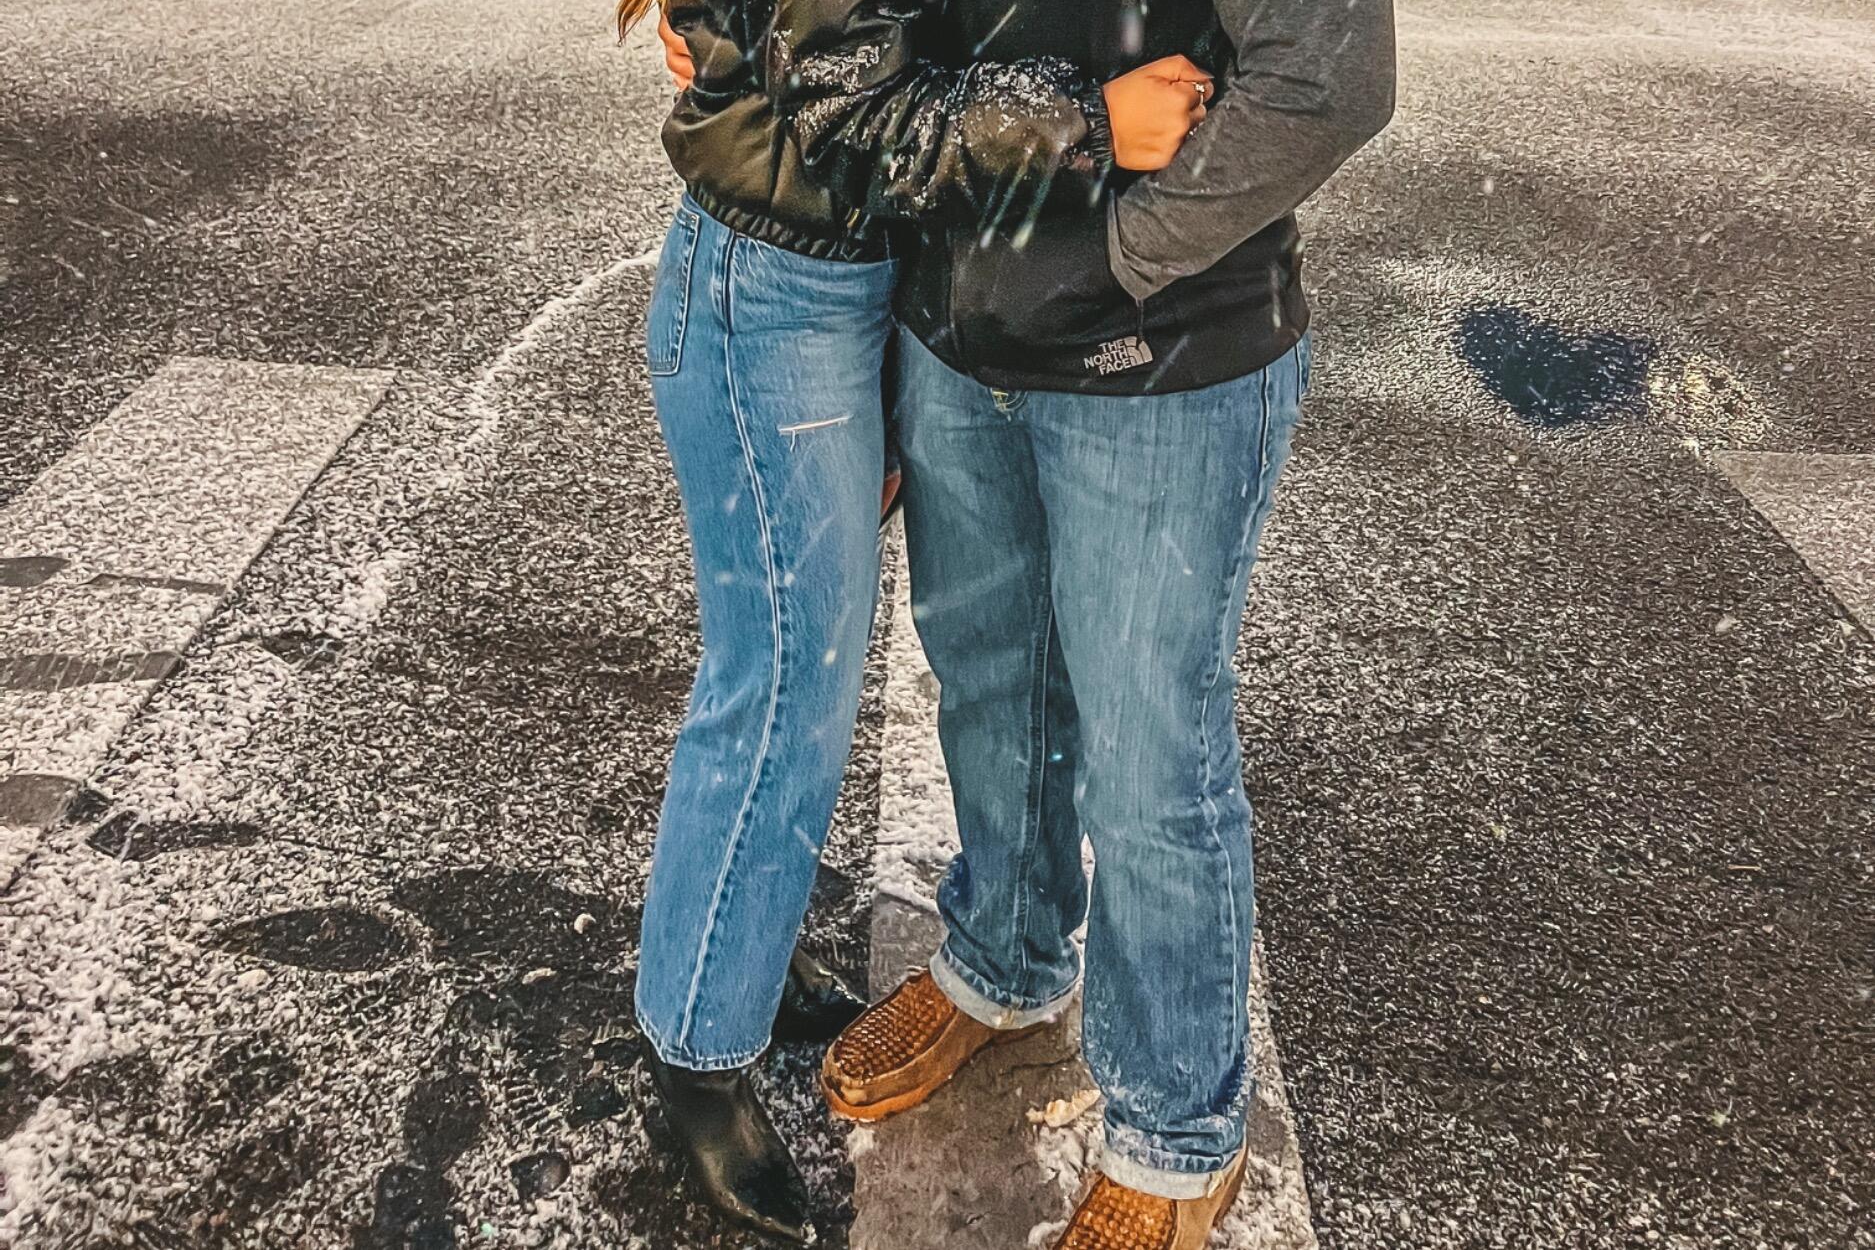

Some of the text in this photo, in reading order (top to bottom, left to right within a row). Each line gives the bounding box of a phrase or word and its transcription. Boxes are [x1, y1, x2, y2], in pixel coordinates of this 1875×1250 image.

[1098, 339, 1125, 353] THE
[1083, 347, 1128, 369] NORTH
[1098, 359, 1132, 376] FACE
